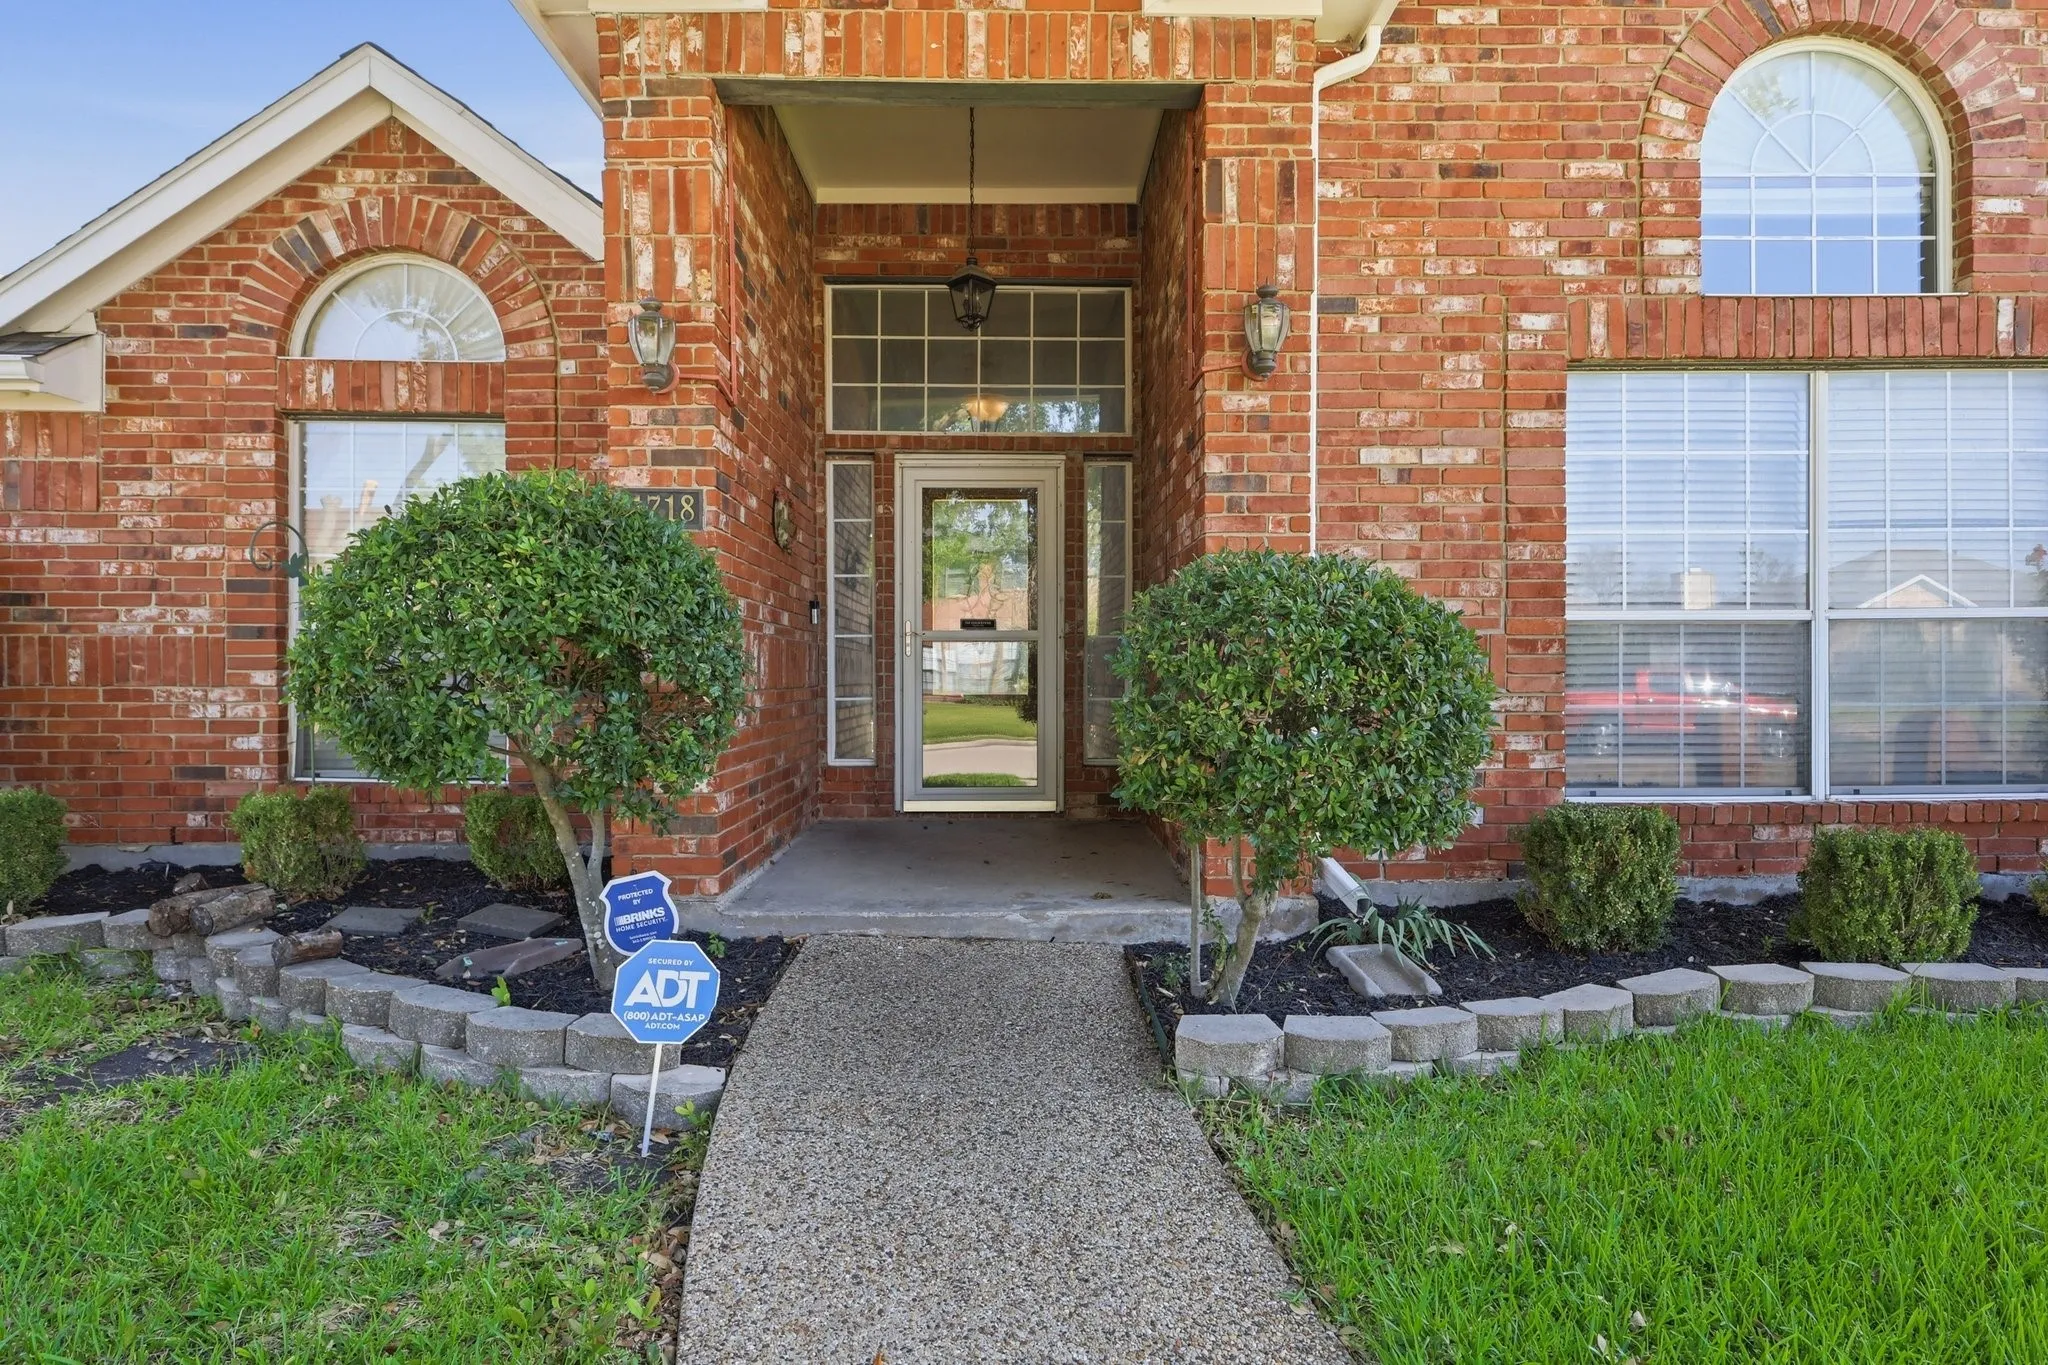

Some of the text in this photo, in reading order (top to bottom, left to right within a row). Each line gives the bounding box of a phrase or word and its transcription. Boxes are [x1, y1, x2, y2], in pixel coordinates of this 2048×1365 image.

[632, 494, 695, 522] 718
[618, 888, 654, 901] PROTECTED
[632, 898, 642, 906] BY
[621, 907, 666, 925] BRINKS
[616, 917, 666, 933] HOME SECURITY
[648, 958, 682, 966] SECURED
[623, 969, 711, 1009] ADT
[645, 1022, 680, 1030] ADT.COM
